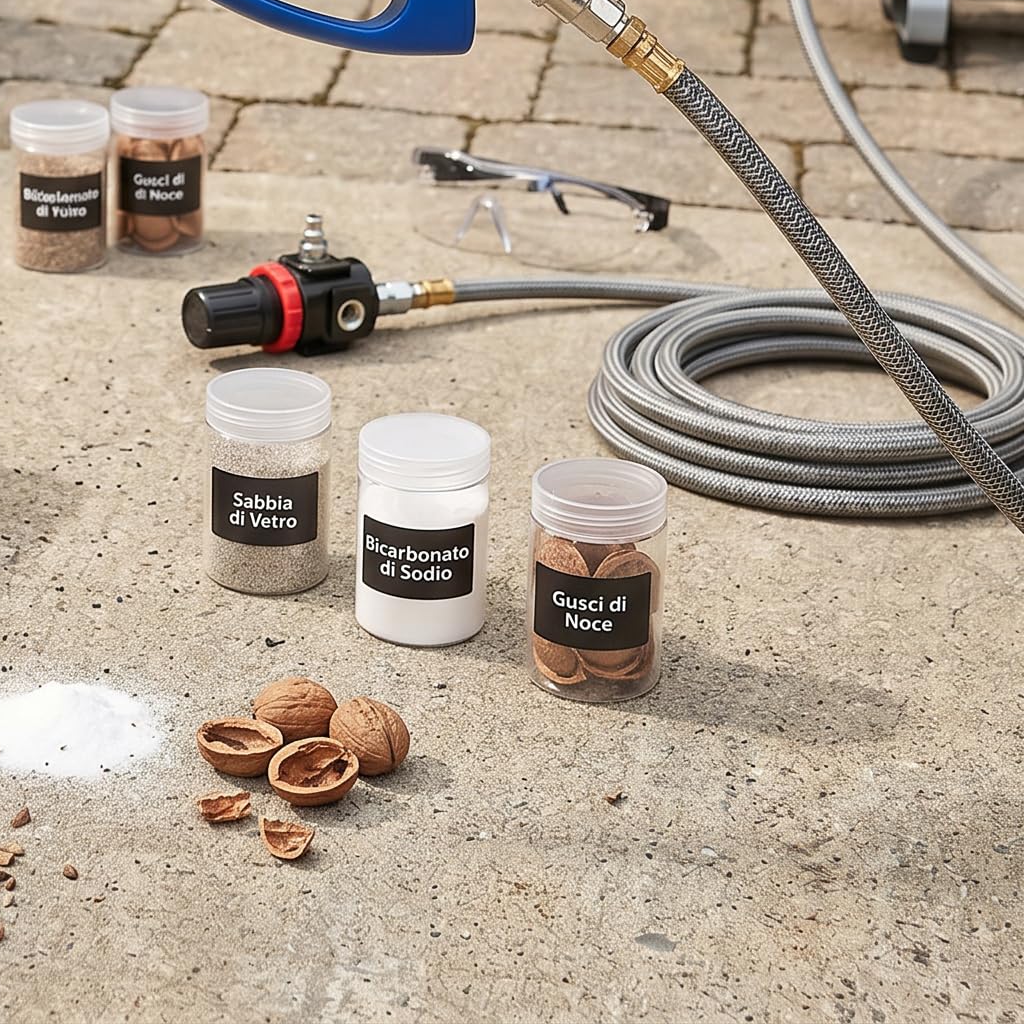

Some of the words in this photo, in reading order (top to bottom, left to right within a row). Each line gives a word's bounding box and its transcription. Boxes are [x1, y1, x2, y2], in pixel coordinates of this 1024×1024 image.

[149, 188, 184, 201] Noce
[232, 492, 293, 511] Sabbia
[229, 509, 245, 527] di
[249, 512, 297, 529] Vetro
[365, 534, 470, 563] Bicarbonato
[379, 559, 396, 577] di
[400, 563, 453, 582] Sodio
[552, 590, 604, 612] Gusci
[609, 595, 627, 612] di
[565, 612, 613, 632] Noce
